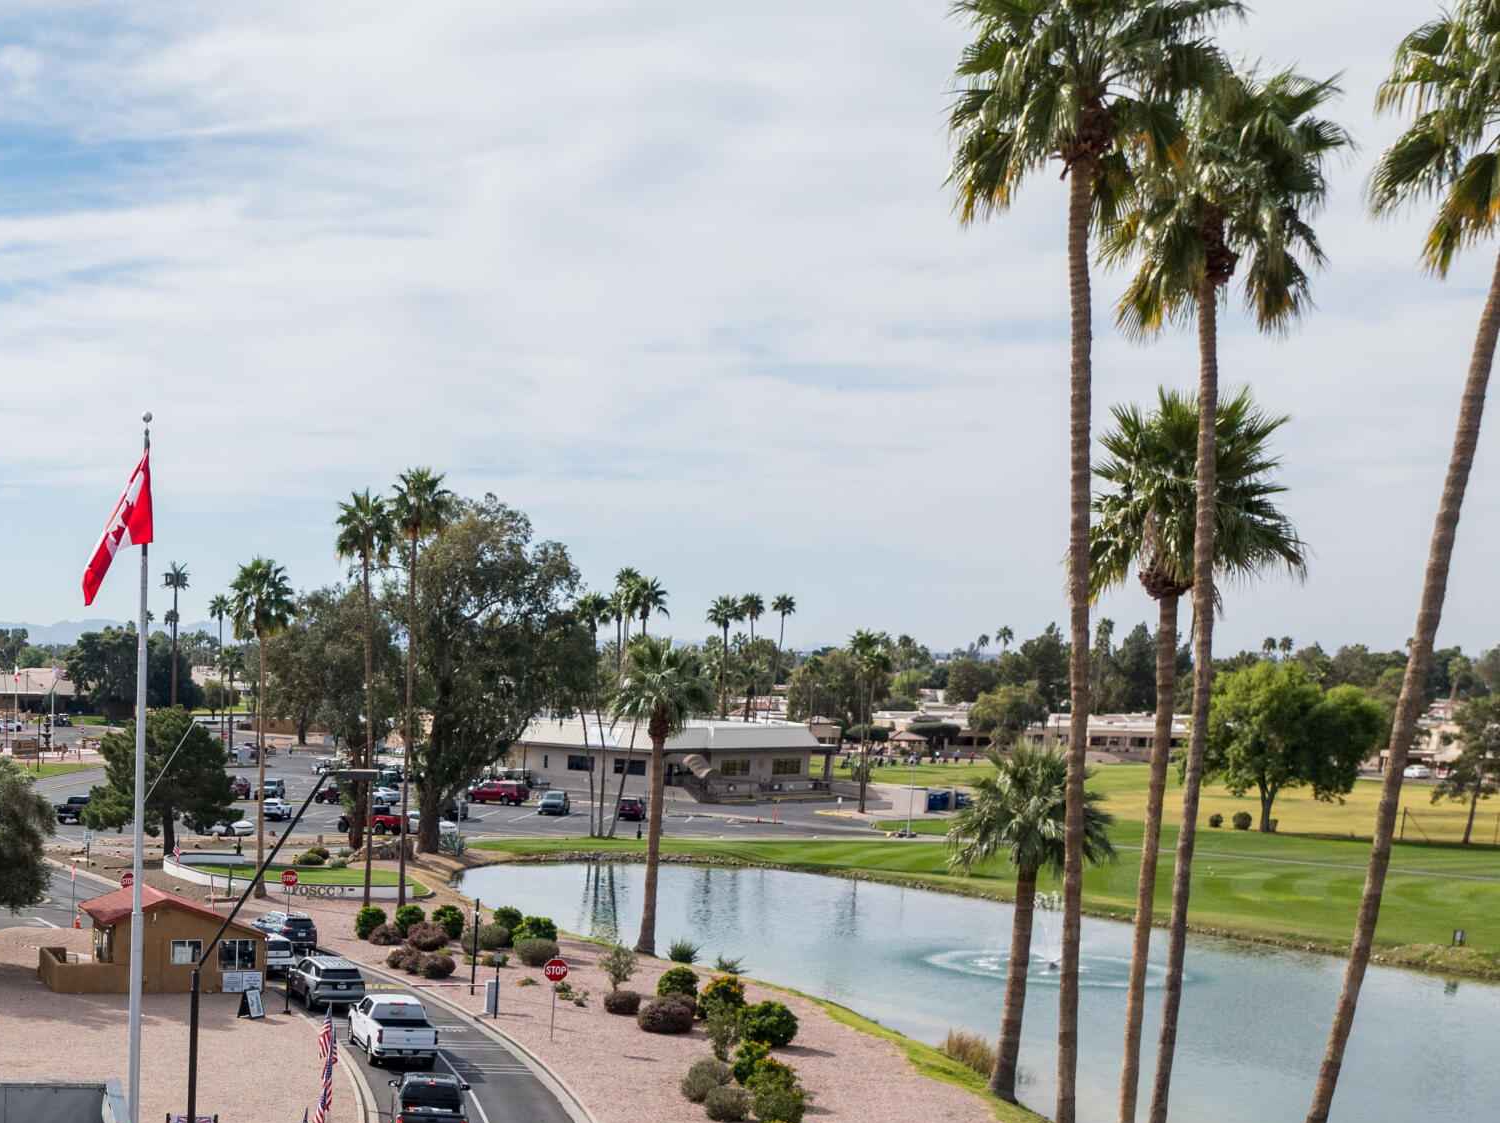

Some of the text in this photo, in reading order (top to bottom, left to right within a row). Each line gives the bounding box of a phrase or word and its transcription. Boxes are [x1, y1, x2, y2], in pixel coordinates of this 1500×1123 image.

[282, 874, 298, 882] STOP
[291, 885, 335, 897] FOSCC
[545, 965, 567, 976] STOP
